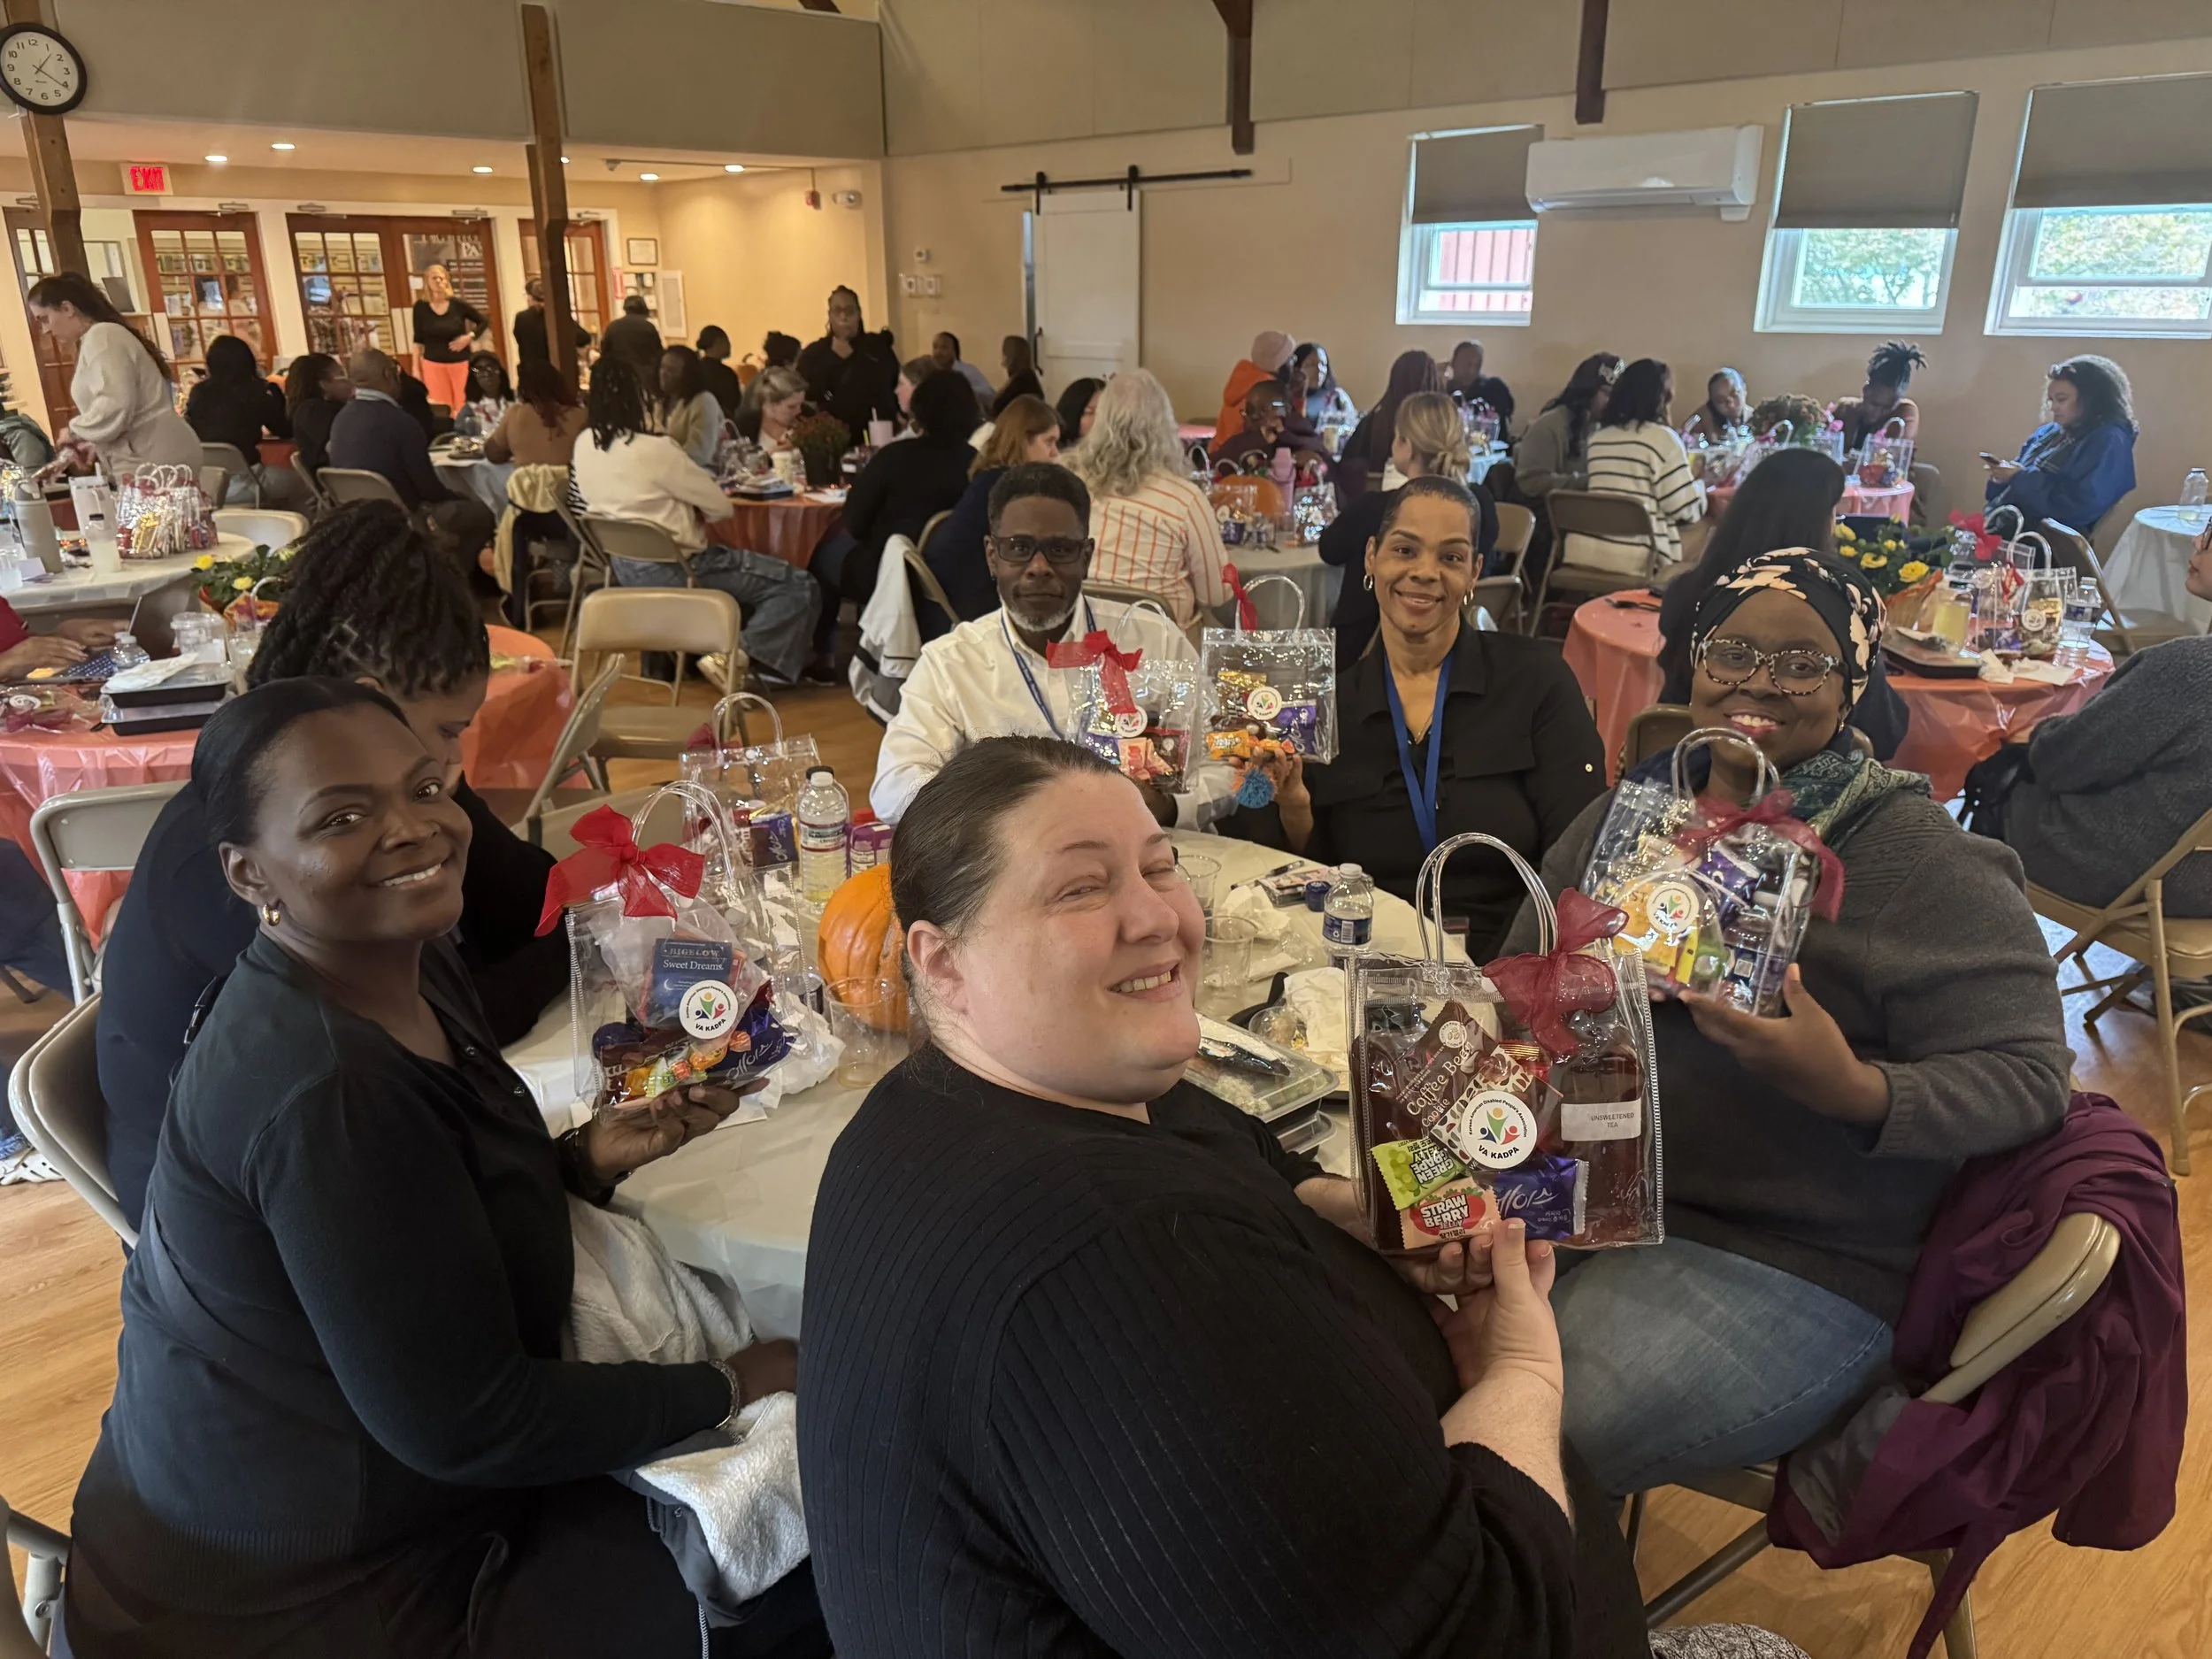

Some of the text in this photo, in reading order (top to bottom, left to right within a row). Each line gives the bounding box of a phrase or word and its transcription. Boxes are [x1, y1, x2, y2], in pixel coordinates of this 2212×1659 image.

[13, 77, 22, 86] 8
[26, 88, 34, 96] 7
[41, 92, 49, 101] 6
[130, 165, 165, 192] EXIT
[663, 959, 688, 970] Sweet
[695, 1018, 726, 1032] VA KADPA
[1407, 1075, 1449, 1115] Coffee
[1502, 1099, 1519, 1113] People's
[1591, 1112, 1635, 1122] UNSWEETENED
[1479, 1145, 1520, 1159] VA KADPA
[1410, 1149, 1448, 1174] GRAPE
[1416, 1158, 1455, 1184] GREEN
[1420, 1194, 1467, 1218] STRAW
[1424, 1205, 1470, 1228] BERRY
